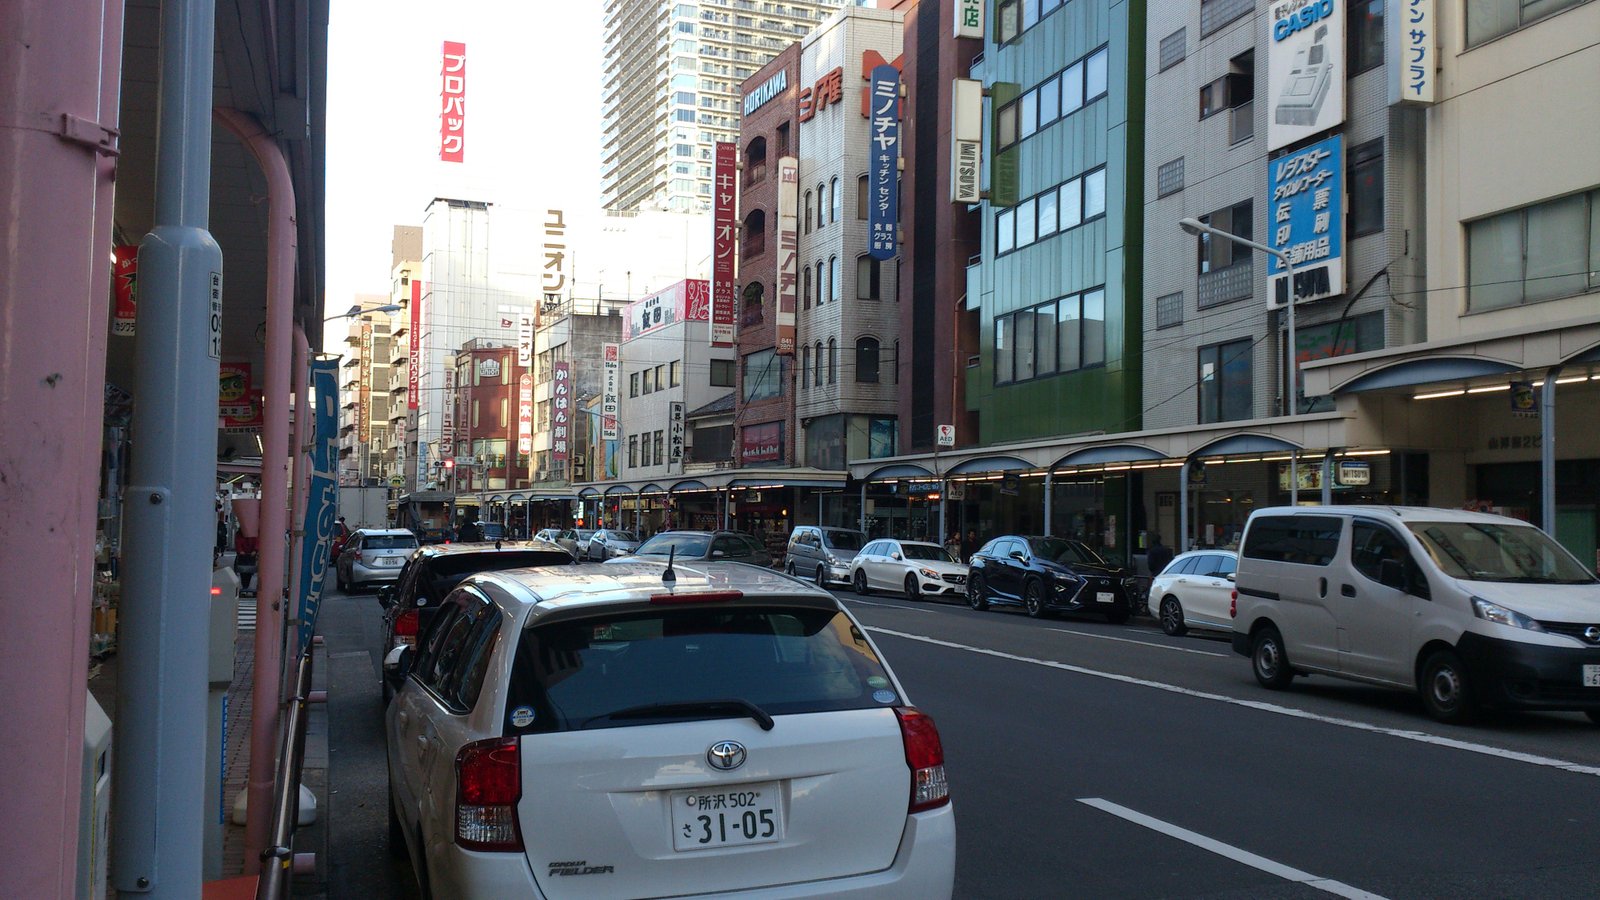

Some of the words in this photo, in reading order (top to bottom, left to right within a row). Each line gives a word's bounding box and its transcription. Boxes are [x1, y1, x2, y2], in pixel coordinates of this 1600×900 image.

[964, 0, 979, 27] 店
[1274, 0, 1334, 42] CASIO
[443, 54, 466, 153] プロパック
[744, 69, 787, 117] HORIKAWA
[873, 80, 897, 150] ミノチヤ
[959, 143, 976, 199] MITSUYA
[1276, 147, 1332, 183] レジスター
[878, 154, 890, 217] キッチンセンター
[716, 173, 733, 258] キャニオン
[1275, 187, 1331, 223] 伝票
[874, 232, 892, 241] グラス
[1275, 211, 1331, 247] 印刷
[543, 209, 566, 291] ユニオン
[1275, 236, 1331, 270] 店舗用品
[641, 306, 662, 330] 飯田
[520, 318, 531, 362] ユニオン
[410, 350, 418, 383] プロパック
[604, 393, 616, 412] 飯田
[673, 422, 683, 458] 小松屋
[698, 793, 727, 810] 所沢
[729, 792, 755, 808] 502
[683, 824, 692, 838] さ
[697, 808, 775, 843] 31-05
[548, 865, 615, 876] FIELDER
